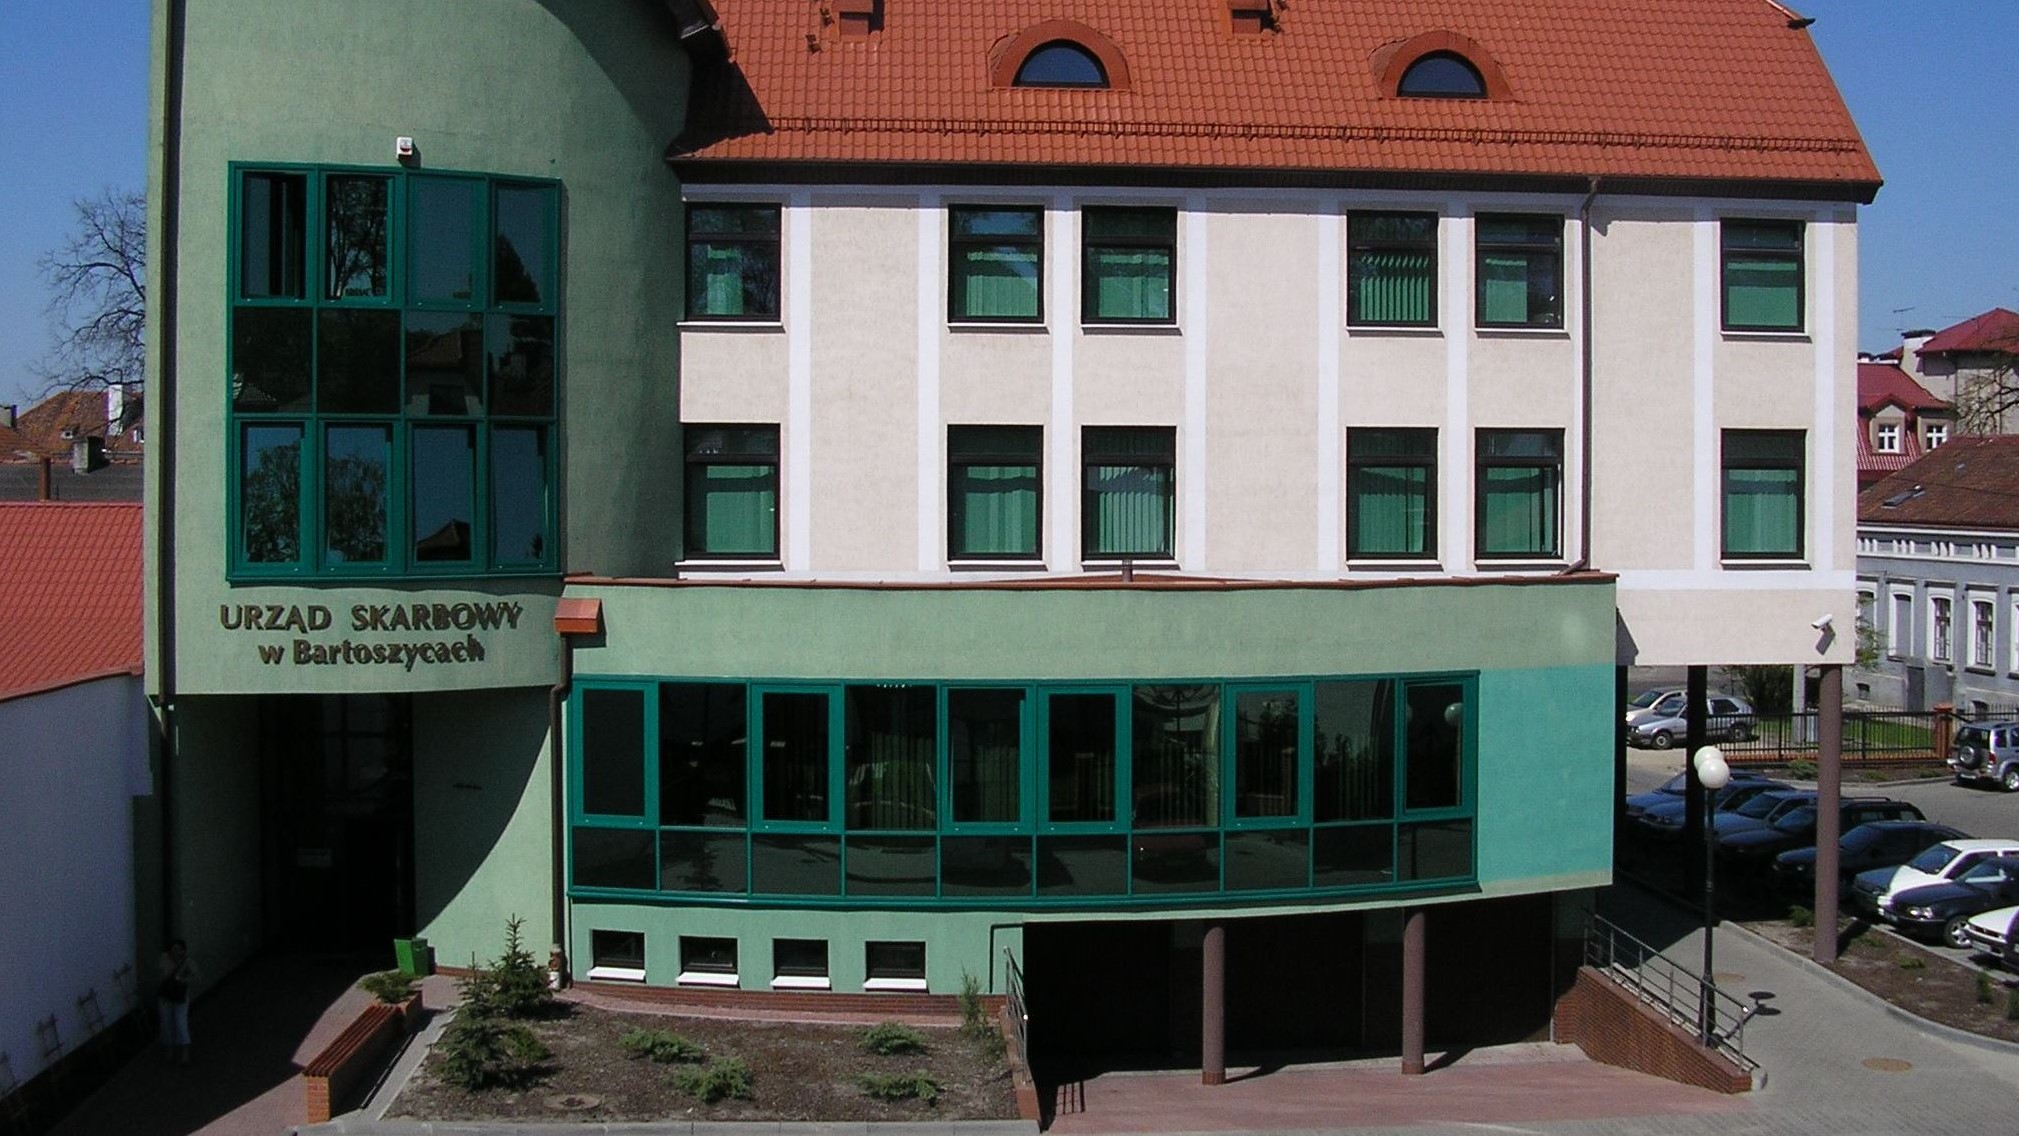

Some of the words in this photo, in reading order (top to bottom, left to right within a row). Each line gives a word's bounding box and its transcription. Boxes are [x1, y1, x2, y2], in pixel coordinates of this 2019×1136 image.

[351, 601, 524, 632] SKARBOWY
[258, 644, 286, 665] w
[293, 634, 486, 672] Bartoszycach
